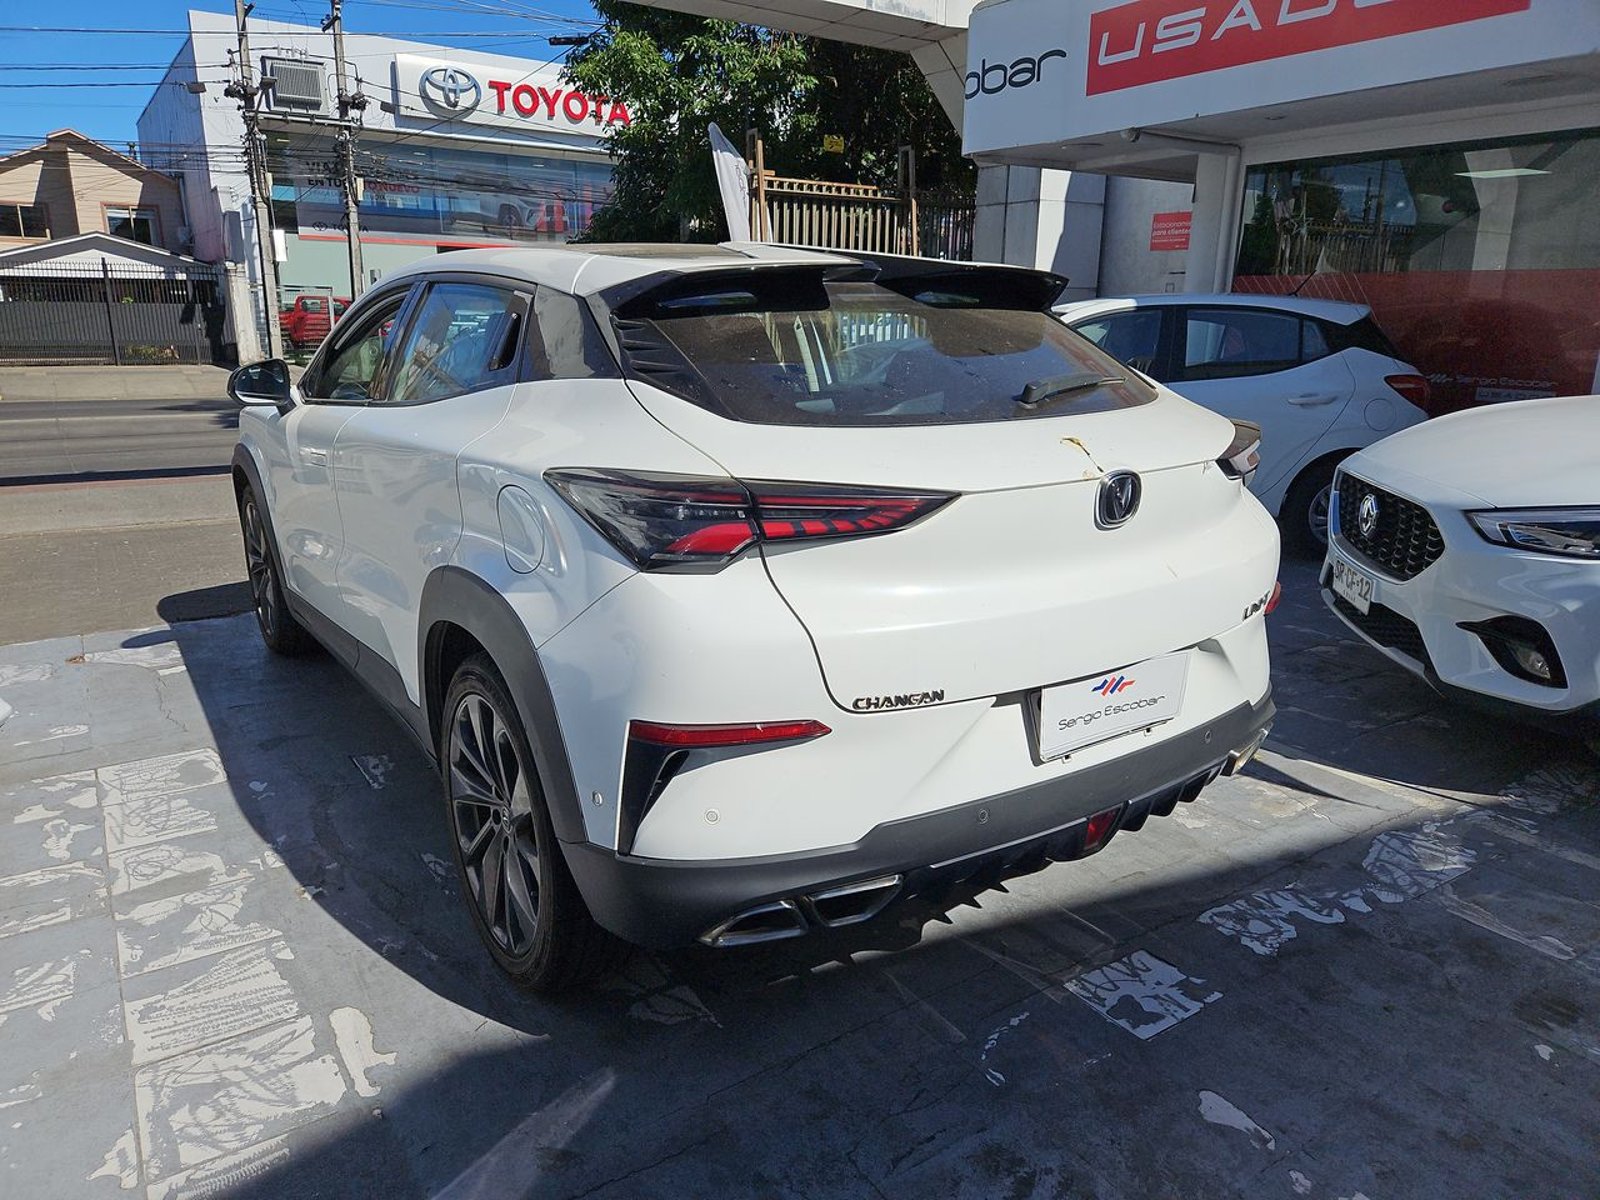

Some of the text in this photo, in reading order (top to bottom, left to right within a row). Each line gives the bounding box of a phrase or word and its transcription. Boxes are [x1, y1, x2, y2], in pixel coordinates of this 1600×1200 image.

[488, 80, 631, 127] TOYOTA
[852, 689, 945, 710] CHANGAN
[1058, 695, 1166, 731] Sergo Escobar
